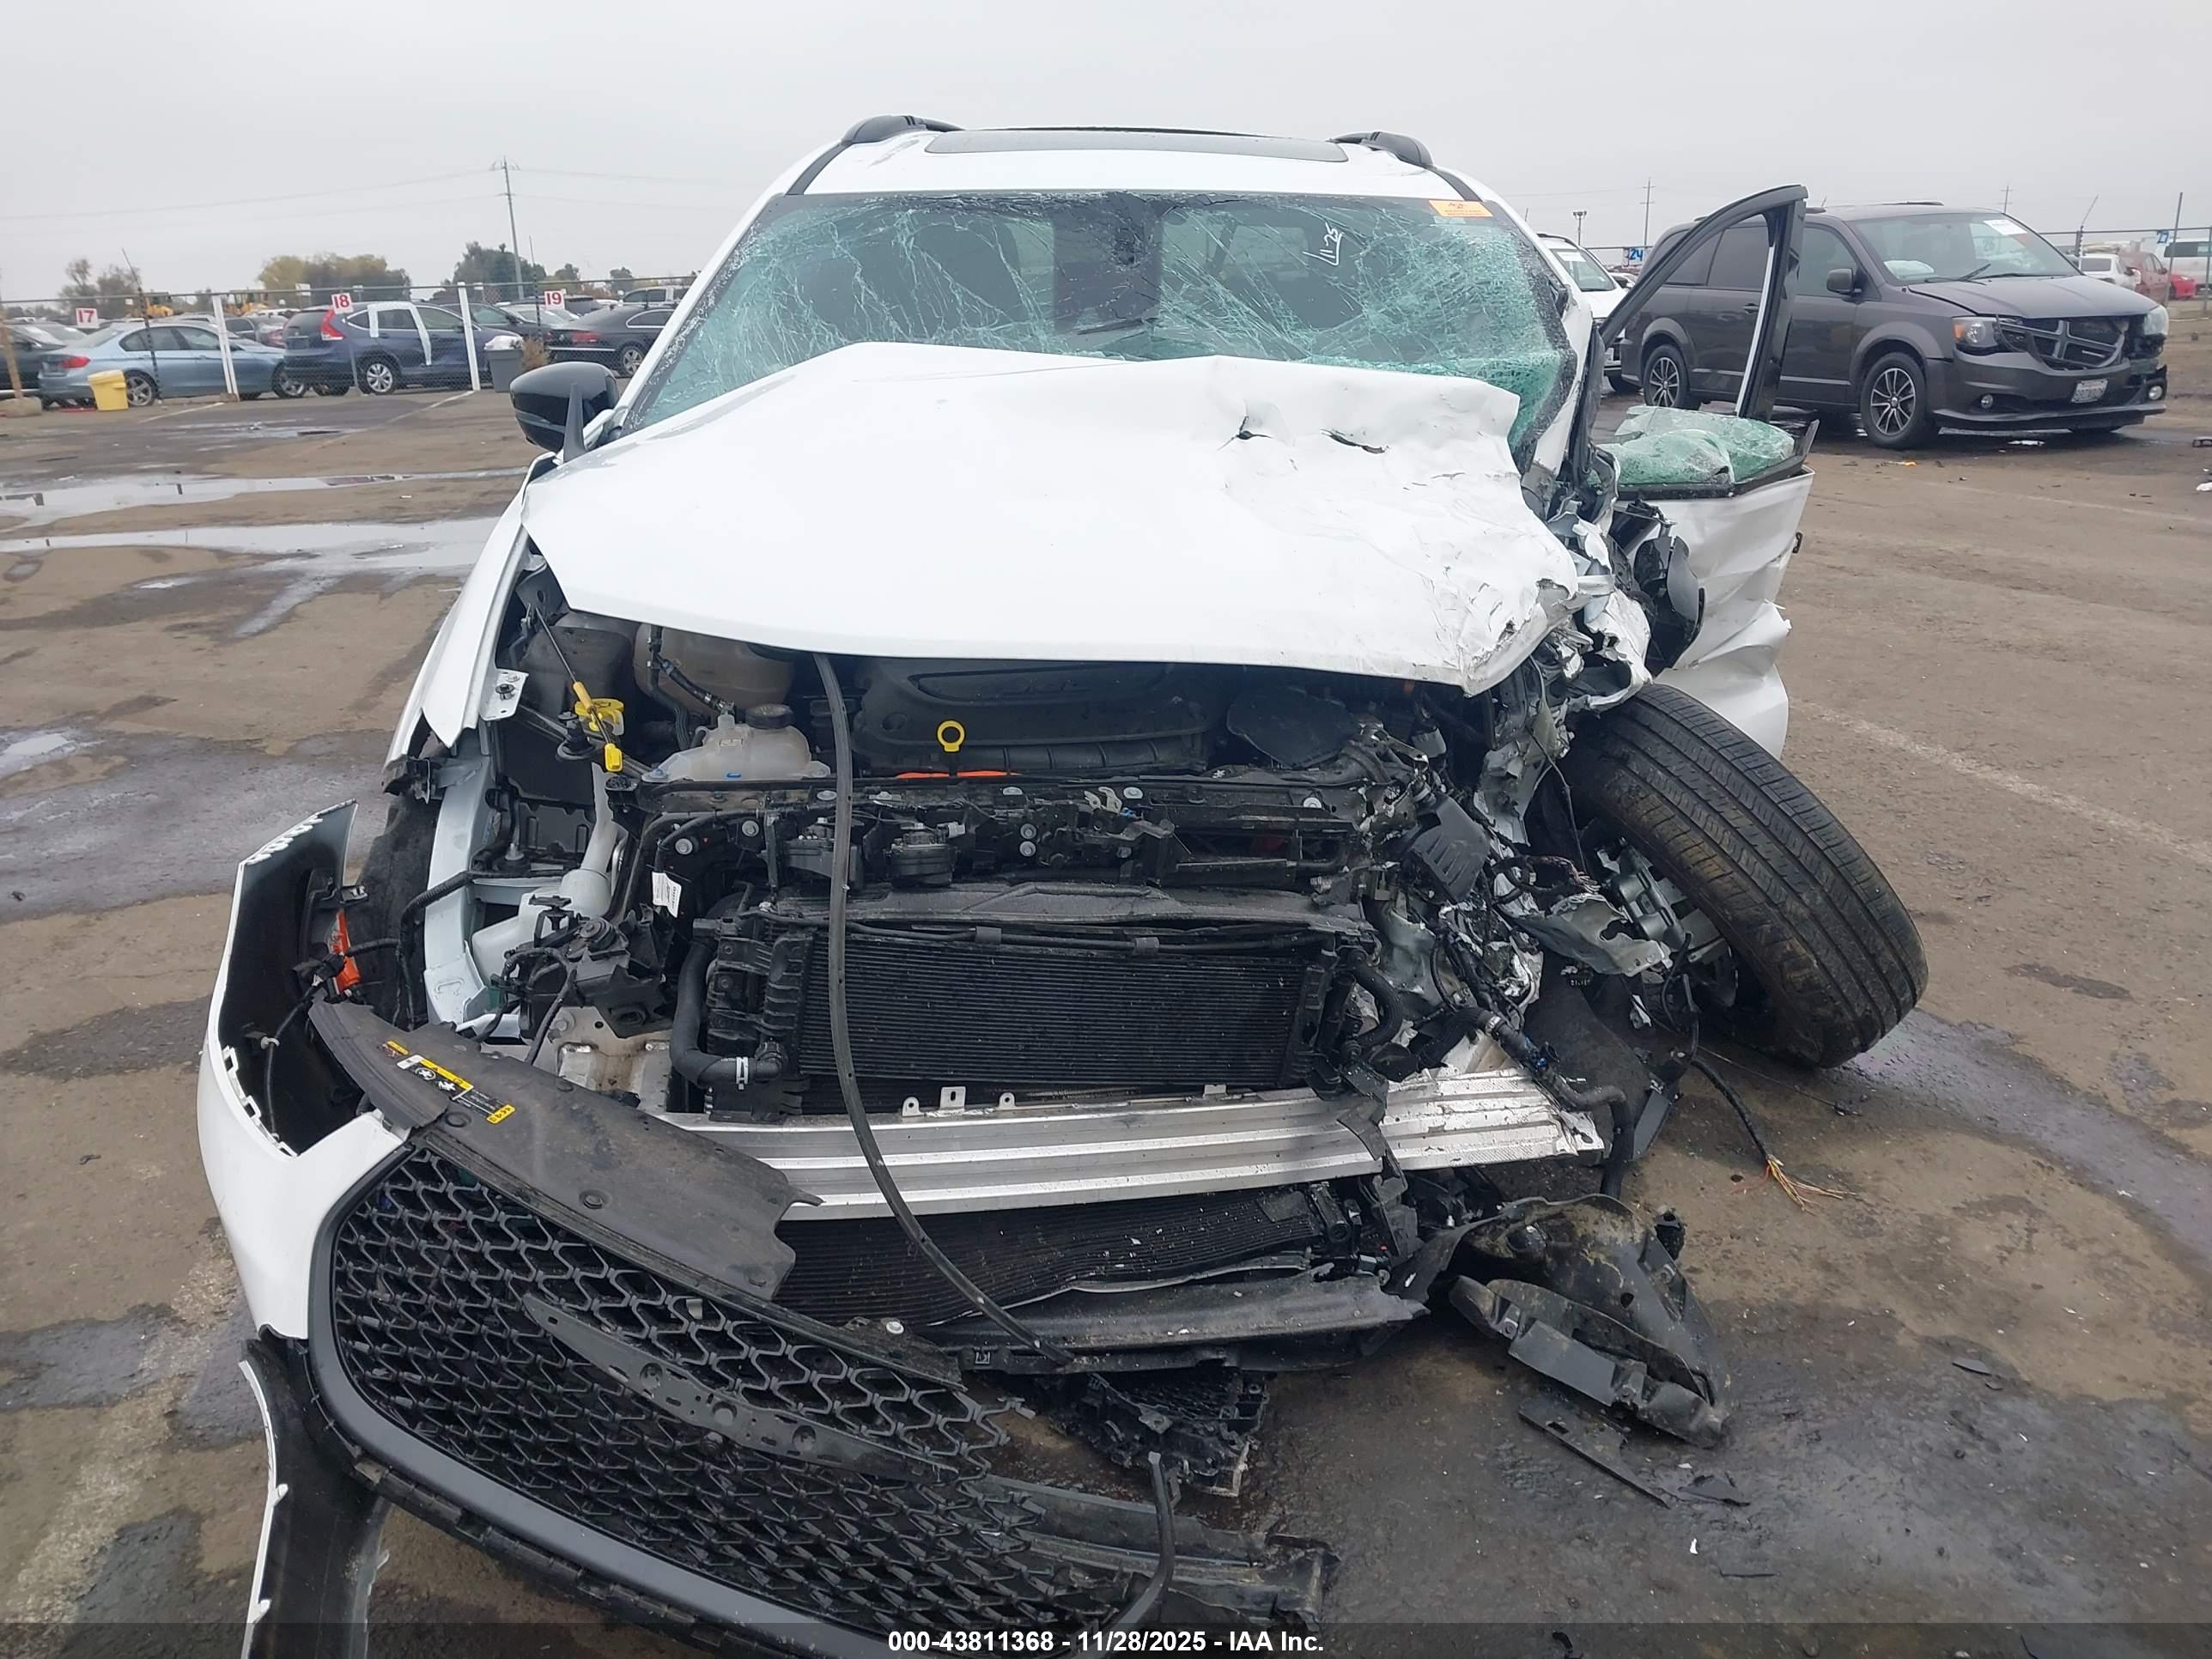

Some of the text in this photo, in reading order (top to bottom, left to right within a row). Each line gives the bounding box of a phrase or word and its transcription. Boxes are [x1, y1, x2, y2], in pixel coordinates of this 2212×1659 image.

[1630, 247, 1644, 261] 24
[334, 295, 349, 309] 18
[546, 292, 562, 305] 19
[79, 309, 94, 323] 17
